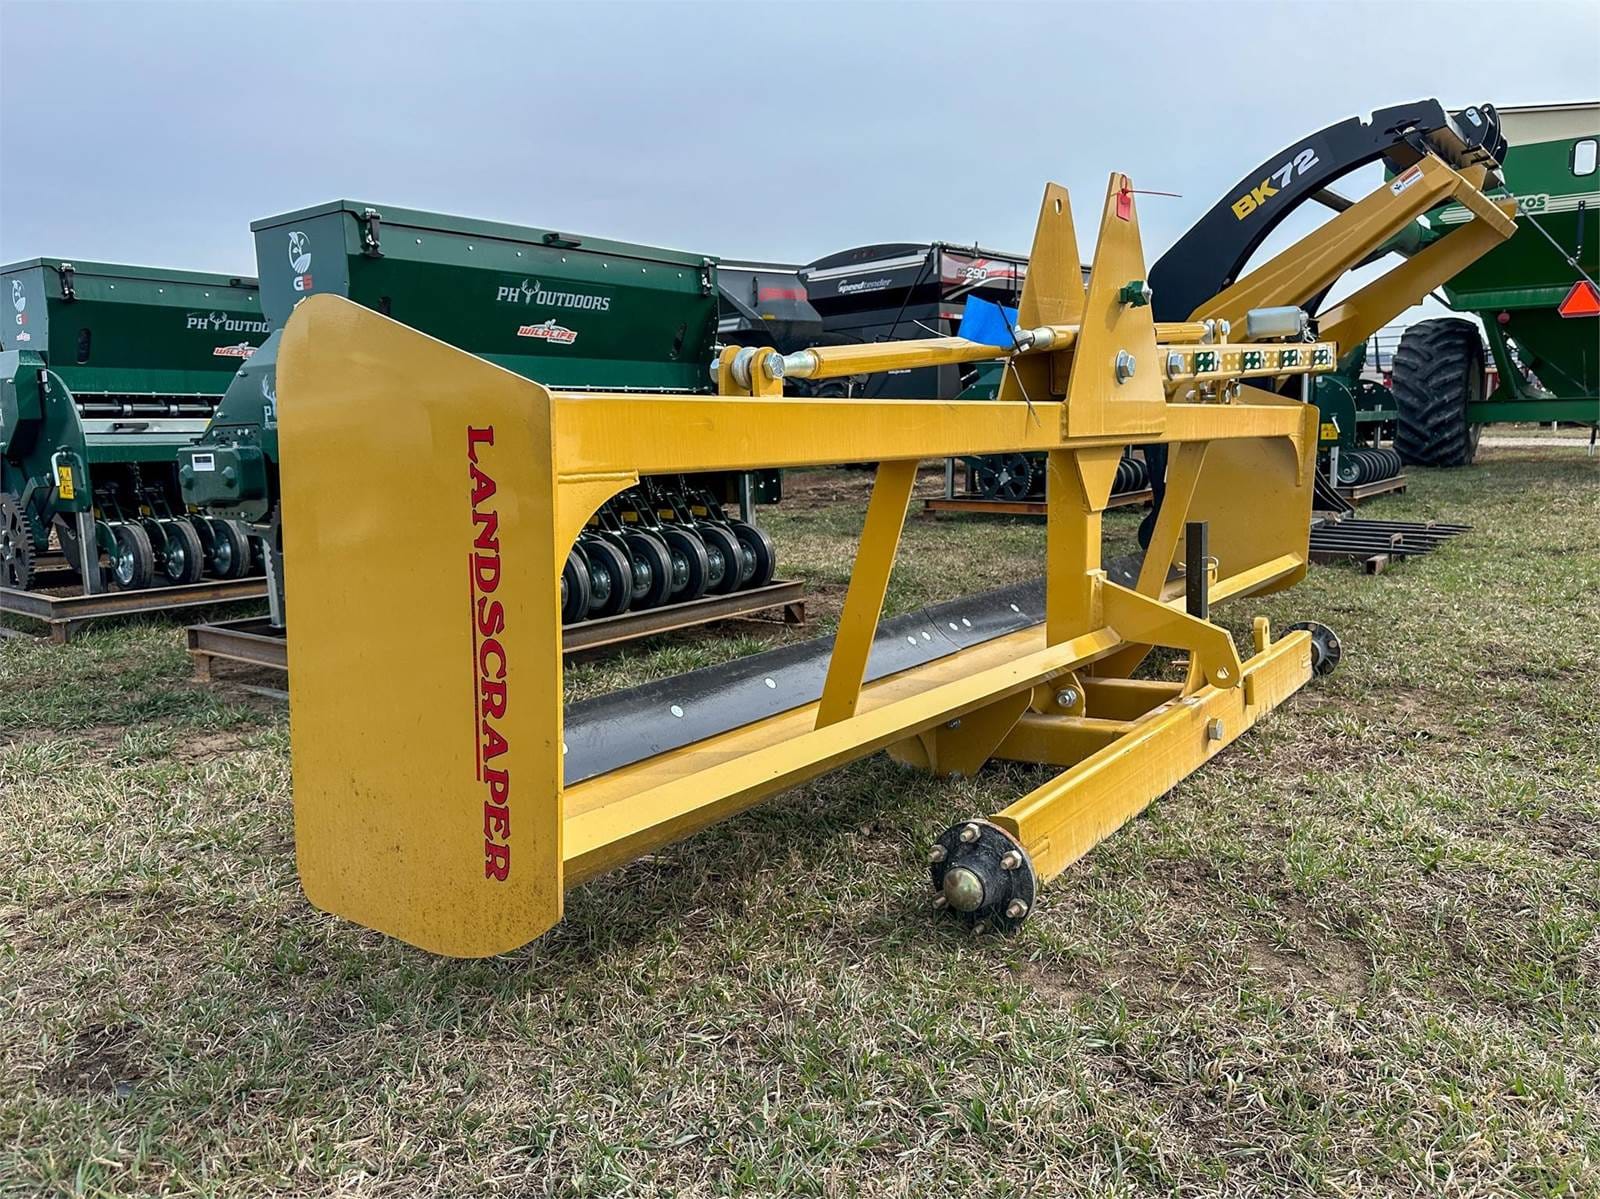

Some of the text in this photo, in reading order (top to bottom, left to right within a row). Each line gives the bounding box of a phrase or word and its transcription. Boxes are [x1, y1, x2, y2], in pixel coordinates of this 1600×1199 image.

[1231, 148, 1320, 220] BK72
[496, 286, 611, 311] PH OUTDOORS
[186, 317, 209, 330] PH
[518, 326, 576, 340] WILDLIFE
[467, 425, 511, 882] LANDSCRAPER
